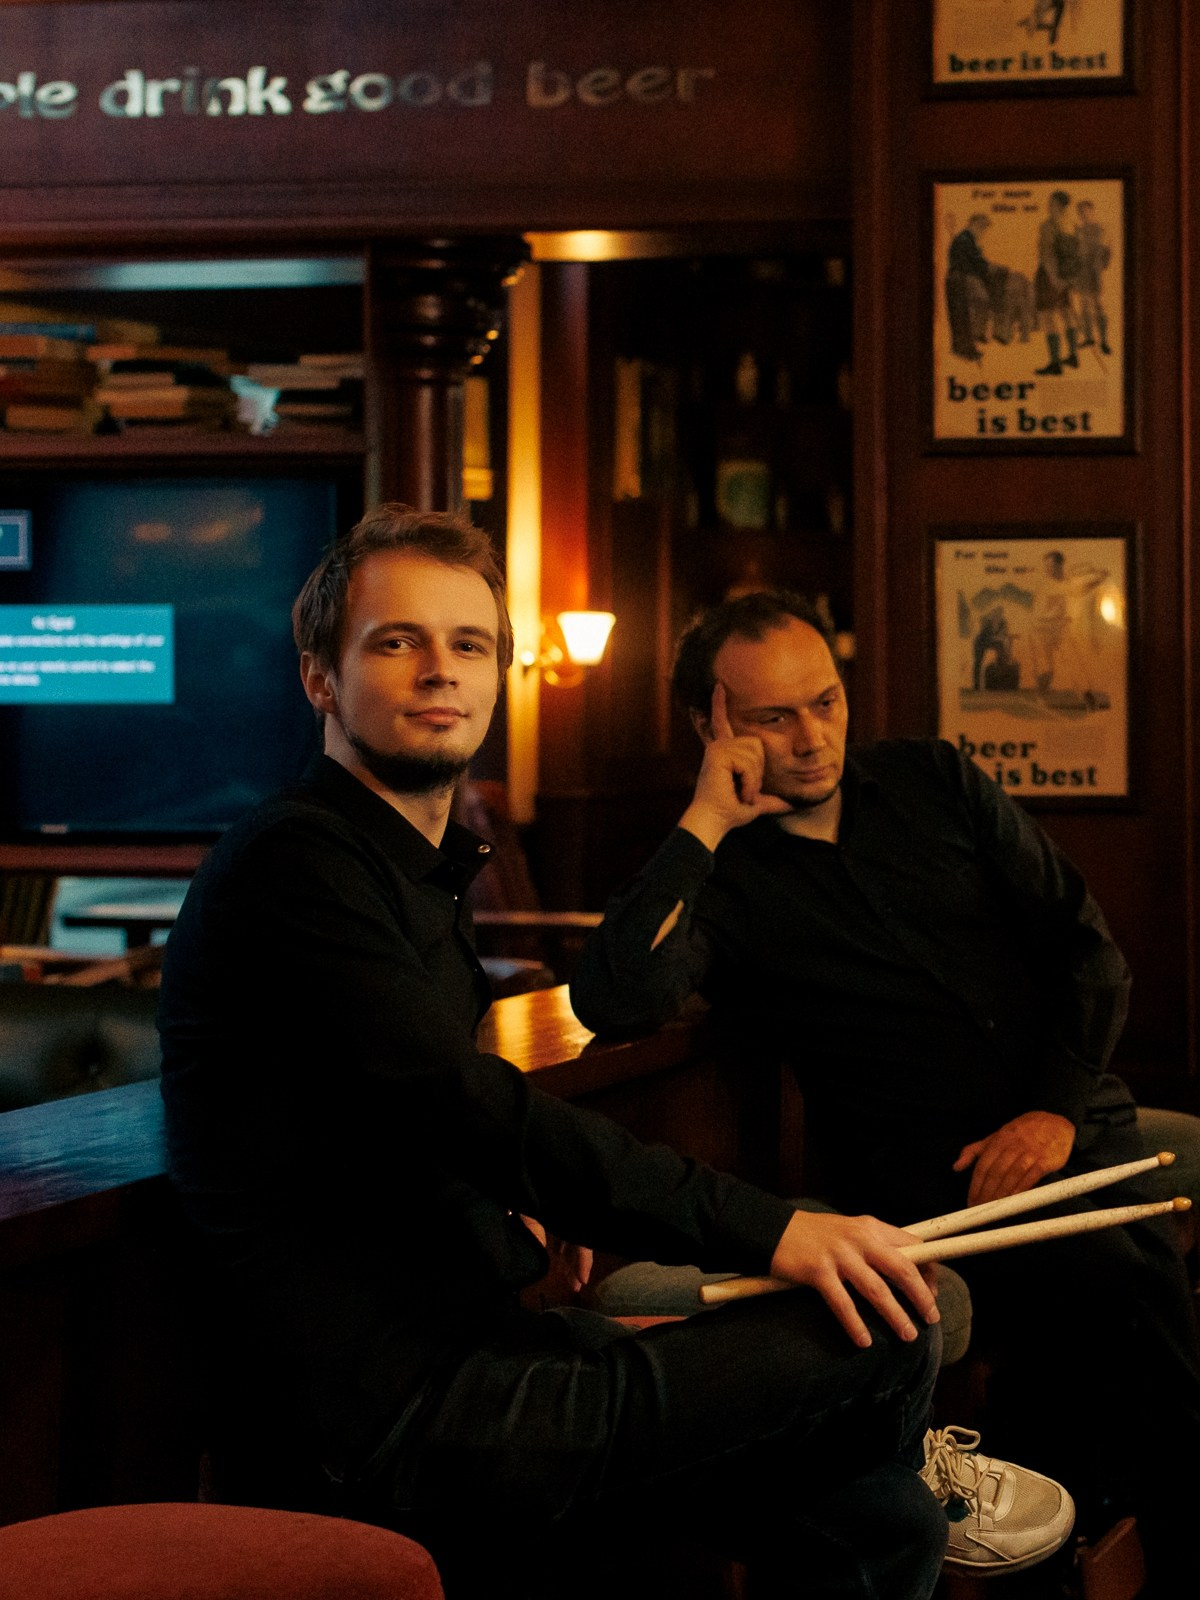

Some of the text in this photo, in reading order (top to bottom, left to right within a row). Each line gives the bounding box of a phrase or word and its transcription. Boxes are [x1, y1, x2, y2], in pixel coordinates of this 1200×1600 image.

[948, 50, 1107, 73] beer is best
[99, 65, 293, 118] drink
[302, 61, 494, 115] good
[526, 59, 716, 109] beer
[947, 375, 1036, 402] beer
[976, 407, 1093, 434] is best
[957, 732, 1037, 759] beer
[995, 761, 1099, 787] is best
